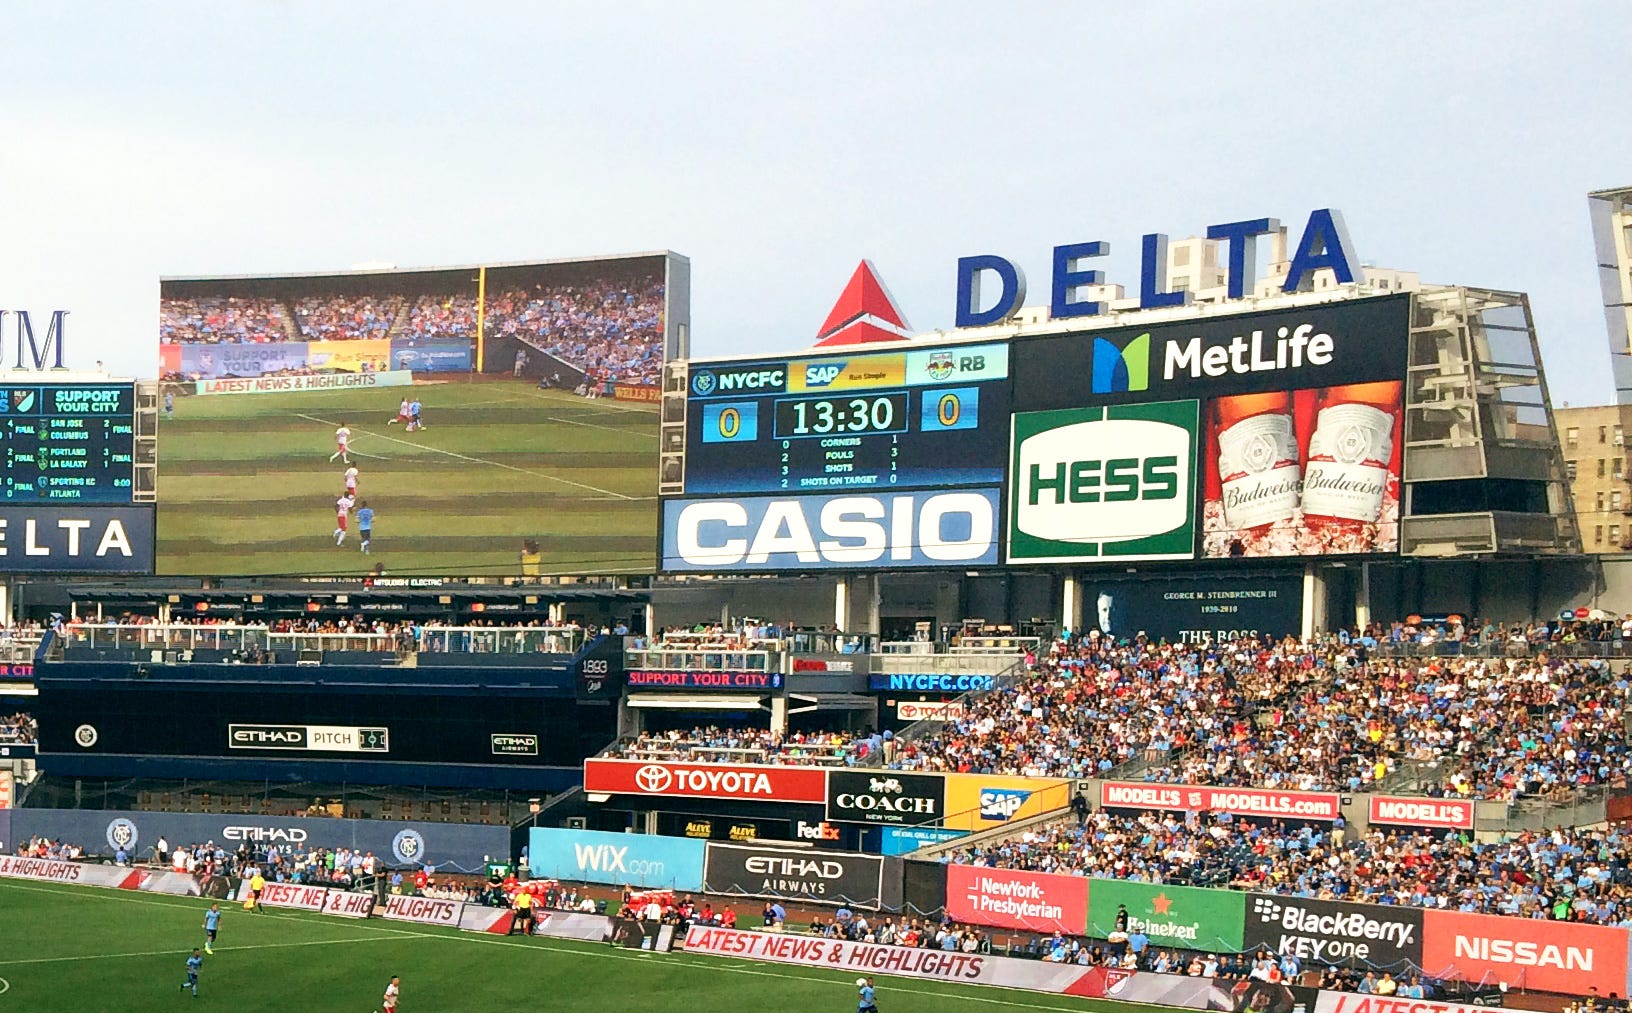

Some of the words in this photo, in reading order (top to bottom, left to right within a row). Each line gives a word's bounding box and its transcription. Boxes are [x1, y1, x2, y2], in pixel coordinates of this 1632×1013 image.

[956, 209, 1363, 327] DELTA
[1164, 323, 1335, 381] MetLife
[960, 356, 986, 372] RB
[205, 379, 252, 393] LATEST
[254, 377, 292, 390] NEWS
[296, 377, 303, 388] &
[306, 374, 376, 387] HIGHLIGHTS
[719, 371, 784, 389] NYCFC
[806, 367, 839, 386] SAP
[56, 391, 120, 402] SUPPORT
[56, 402, 89, 412] YOUR
[91, 402, 120, 412] CITY
[793, 398, 893, 434] 13:30
[938, 394, 960, 426] 0
[719, 407, 740, 438] 0
[821, 437, 861, 448] CORNERS
[826, 451, 854, 459] FOULS
[825, 463, 853, 472] SHOTS
[800, 478, 827, 487] SHOTS
[830, 477, 842, 486] ON
[844, 475, 878, 485] TARGET
[1029, 456, 1178, 505] HESS
[1306, 468, 1383, 495] Budweiser
[677, 493, 993, 566] CASIO
[1164, 592, 1195, 600] GEORGE
[1208, 591, 1267, 599] STEINBRENNER
[1178, 630, 1211, 643] THE
[629, 672, 686, 684] SUPPORT
[692, 673, 731, 685] YOUR
[741, 674, 769, 685] CITY
[234, 730, 302, 743] ETIHAD
[314, 733, 352, 745] PITCH
[494, 738, 535, 747] ETIHAD
[674, 769, 773, 796] TOYOTA
[836, 794, 935, 814] COACH
[980, 793, 1021, 814] SAP
[1108, 786, 1180, 806] MODELL'S
[1211, 793, 1331, 815] MODELLS.com
[1379, 802, 1464, 822] MODELL'S
[223, 825, 307, 842] ETIHAD
[797, 821, 840, 840] FedEx
[2, 858, 12, 874] &
[12, 859, 81, 880] HIGHLIGHTS
[745, 855, 843, 879] ETIHAD
[762, 879, 826, 895] AIRWAYS
[981, 877, 1045, 899] NewYork-
[331, 891, 342, 911] &
[980, 897, 1063, 918] Presbyterian
[1127, 917, 1200, 939] Heineken
[1282, 906, 1410, 948] BlackBerry
[685, 927, 762, 955] LATEST
[762, 933, 823, 962] NEWS
[828, 943, 843, 963] &
[848, 945, 985, 979] HIGHLIGHTS
[1455, 934, 1593, 971] NISSAN
